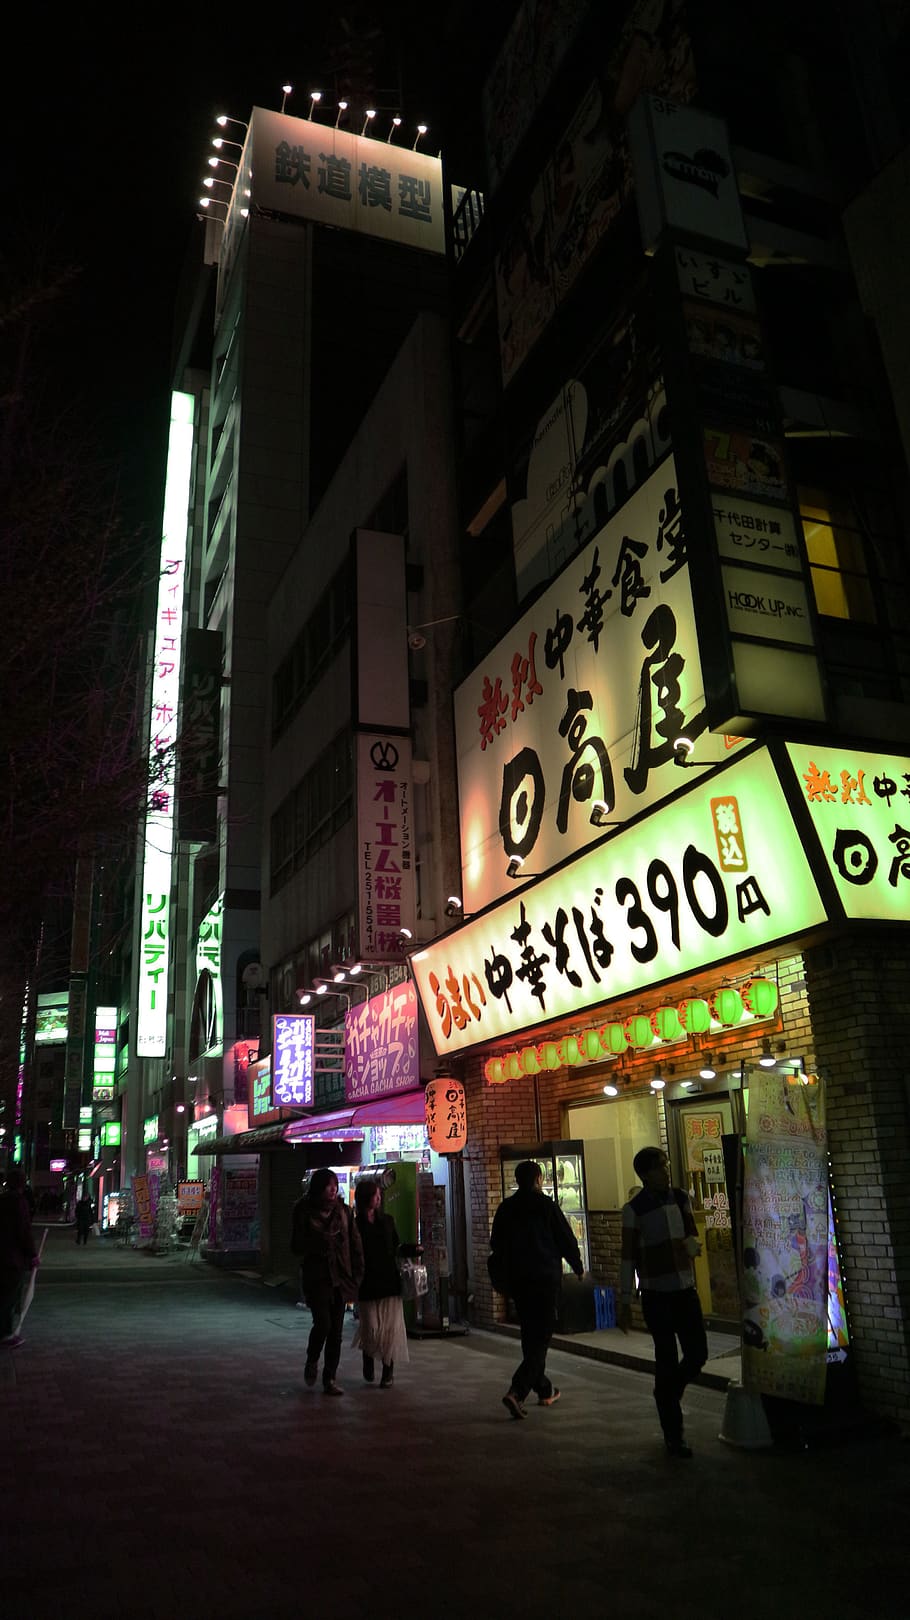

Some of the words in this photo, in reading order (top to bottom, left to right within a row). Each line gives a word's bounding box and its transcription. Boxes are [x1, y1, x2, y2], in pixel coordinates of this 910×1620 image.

[274, 141, 432, 223] 鉄道模型
[712, 508, 780, 535] 千代田計算
[728, 590, 765, 611] HOOK
[499, 604, 708, 860] 日高屋
[715, 803, 744, 867] 税込
[144, 893, 166, 1010] リバティー
[348, 1083, 370, 1101] GACHA
[371, 1076, 394, 1095] GACHA
[396, 1074, 416, 1089] SHOP
[445, 1089, 462, 1139] 日高屋
